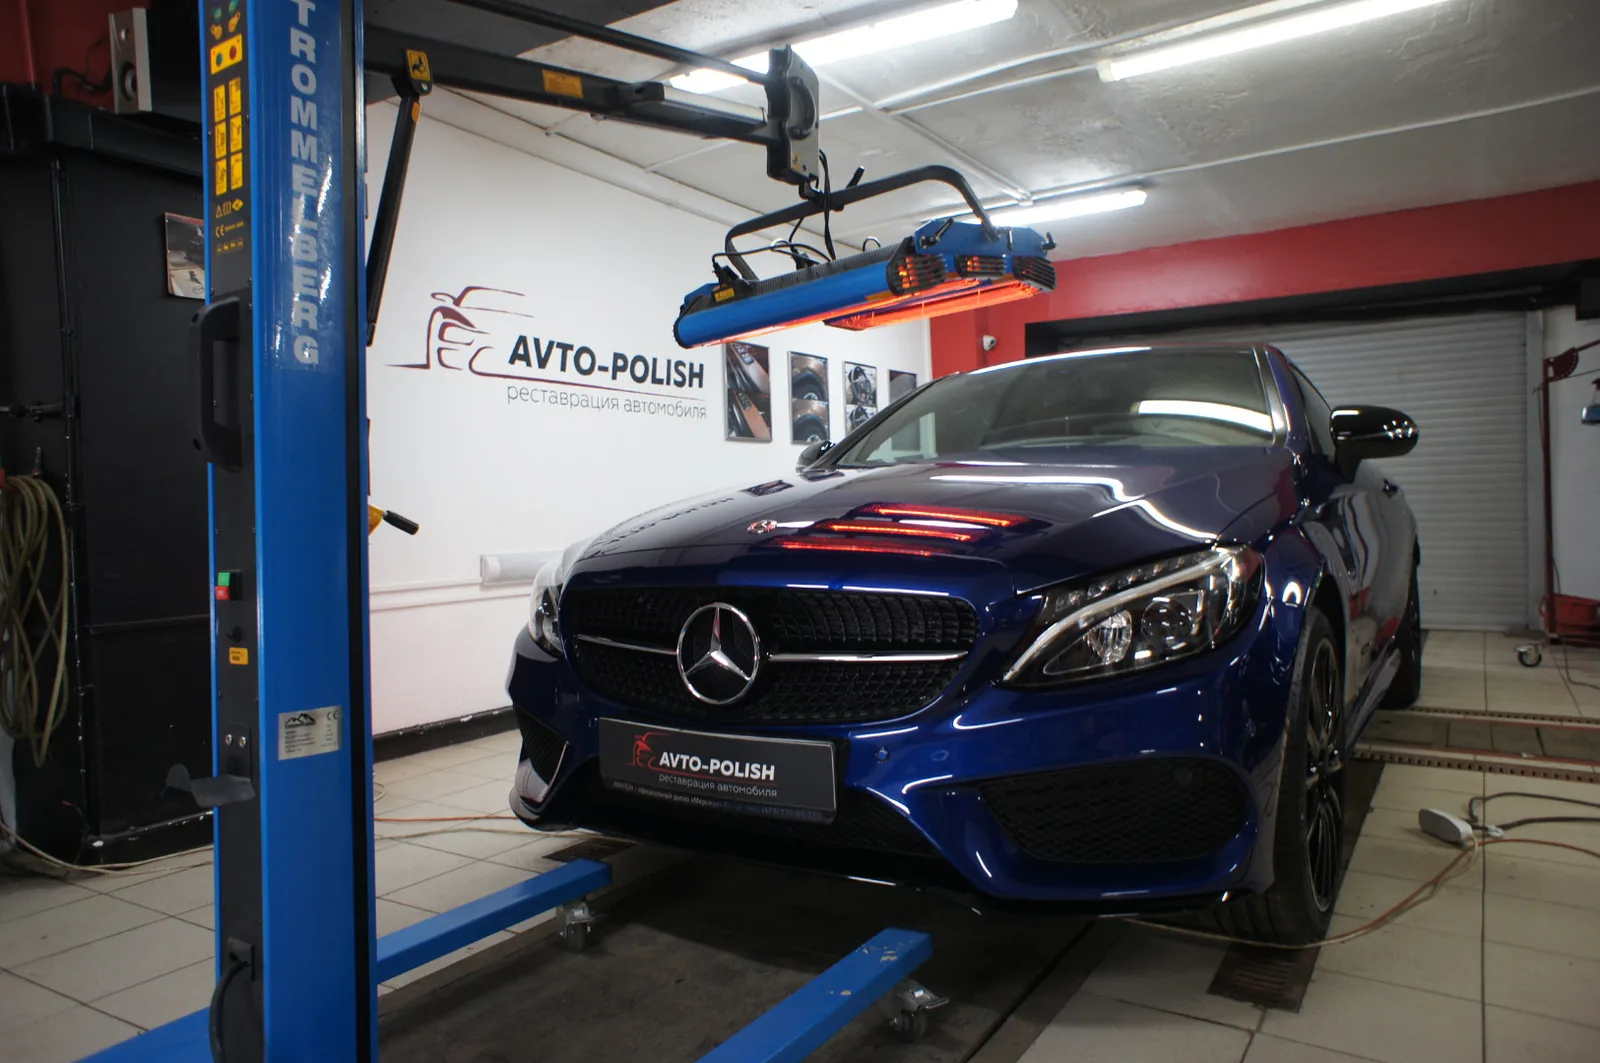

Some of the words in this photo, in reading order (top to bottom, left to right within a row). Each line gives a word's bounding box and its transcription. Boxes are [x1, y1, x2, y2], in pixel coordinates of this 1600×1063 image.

[290, 0, 320, 366] TROMMELBERG
[508, 334, 704, 389] AVTO-POLISH
[507, 384, 620, 412] реставрация
[623, 397, 707, 420] автомобиля
[659, 751, 776, 781] AVTO-POLISH
[658, 773, 716, 791] реставрация
[717, 782, 778, 799] автомобиля
